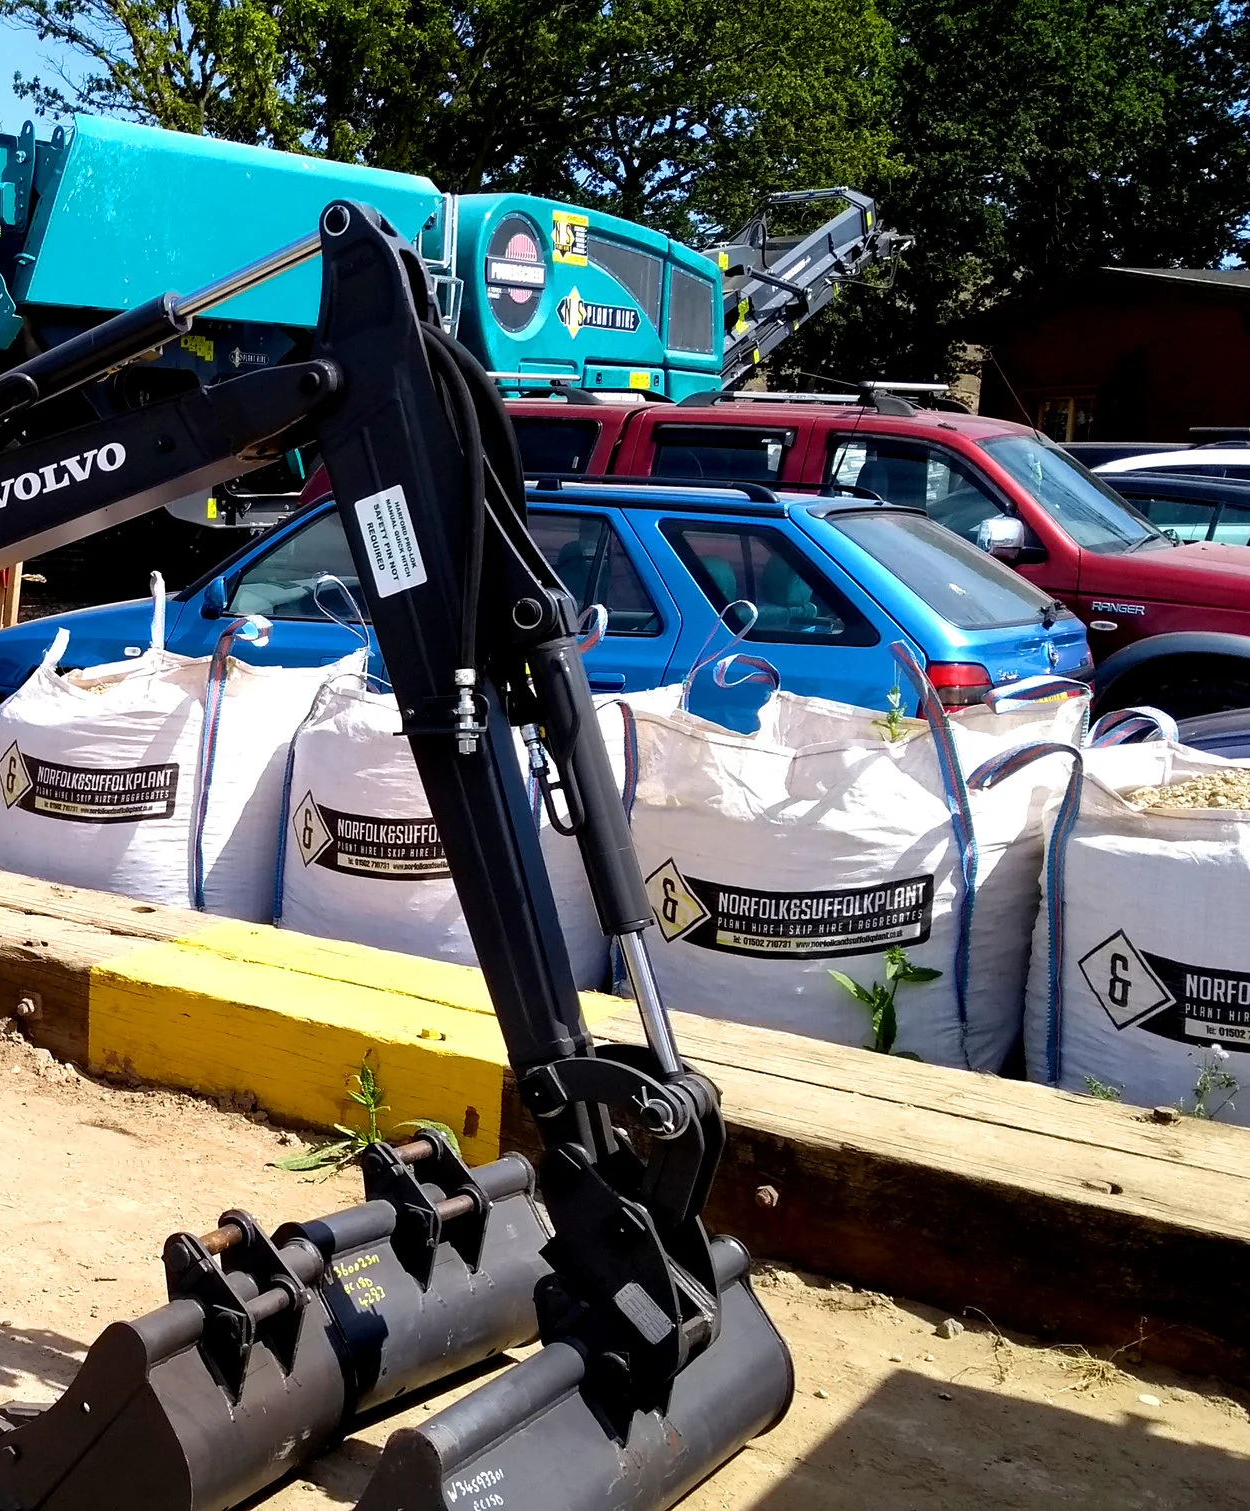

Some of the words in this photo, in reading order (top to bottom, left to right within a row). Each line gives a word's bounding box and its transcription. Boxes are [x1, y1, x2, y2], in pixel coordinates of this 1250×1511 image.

[586, 305, 614, 326] PLANT
[616, 309, 636, 329] HIRE
[366, 522, 386, 571] REQUIRED
[373, 503, 388, 540] SAFETY
[384, 542, 394, 560] PIN
[389, 561, 399, 581] NOT
[385, 498, 397, 529] MANUAL
[394, 530, 404, 554] QUICK
[401, 555, 411, 578] HITCH
[394, 501, 407, 536] HARFORD
[406, 536, 417, 569] PRO-LOK
[1092, 601, 1145, 616] RANGER
[37, 765, 173, 791] NORFOLK&SUFFOLKPLANT
[121, 789, 170, 803] AGGREGATES
[387, 848, 406, 858] SKIP
[410, 847, 429, 858] HIRE
[718, 882, 926, 920] NORFOLK&SUFFOLKPLANT
[718, 917, 745, 931] PLANT
[752, 923, 774, 934] HIRE
[789, 925, 813, 935] SKIP
[819, 922, 843, 934] HIRE
[858, 909, 923, 930] AGGREGATES
[743, 937, 764, 947] 01502
[766, 940, 791, 949] 710731
[1186, 974, 1250, 1005] NORFO
[1185, 1003, 1221, 1020] PLANT
[1219, 1027, 1246, 1039] 01502
